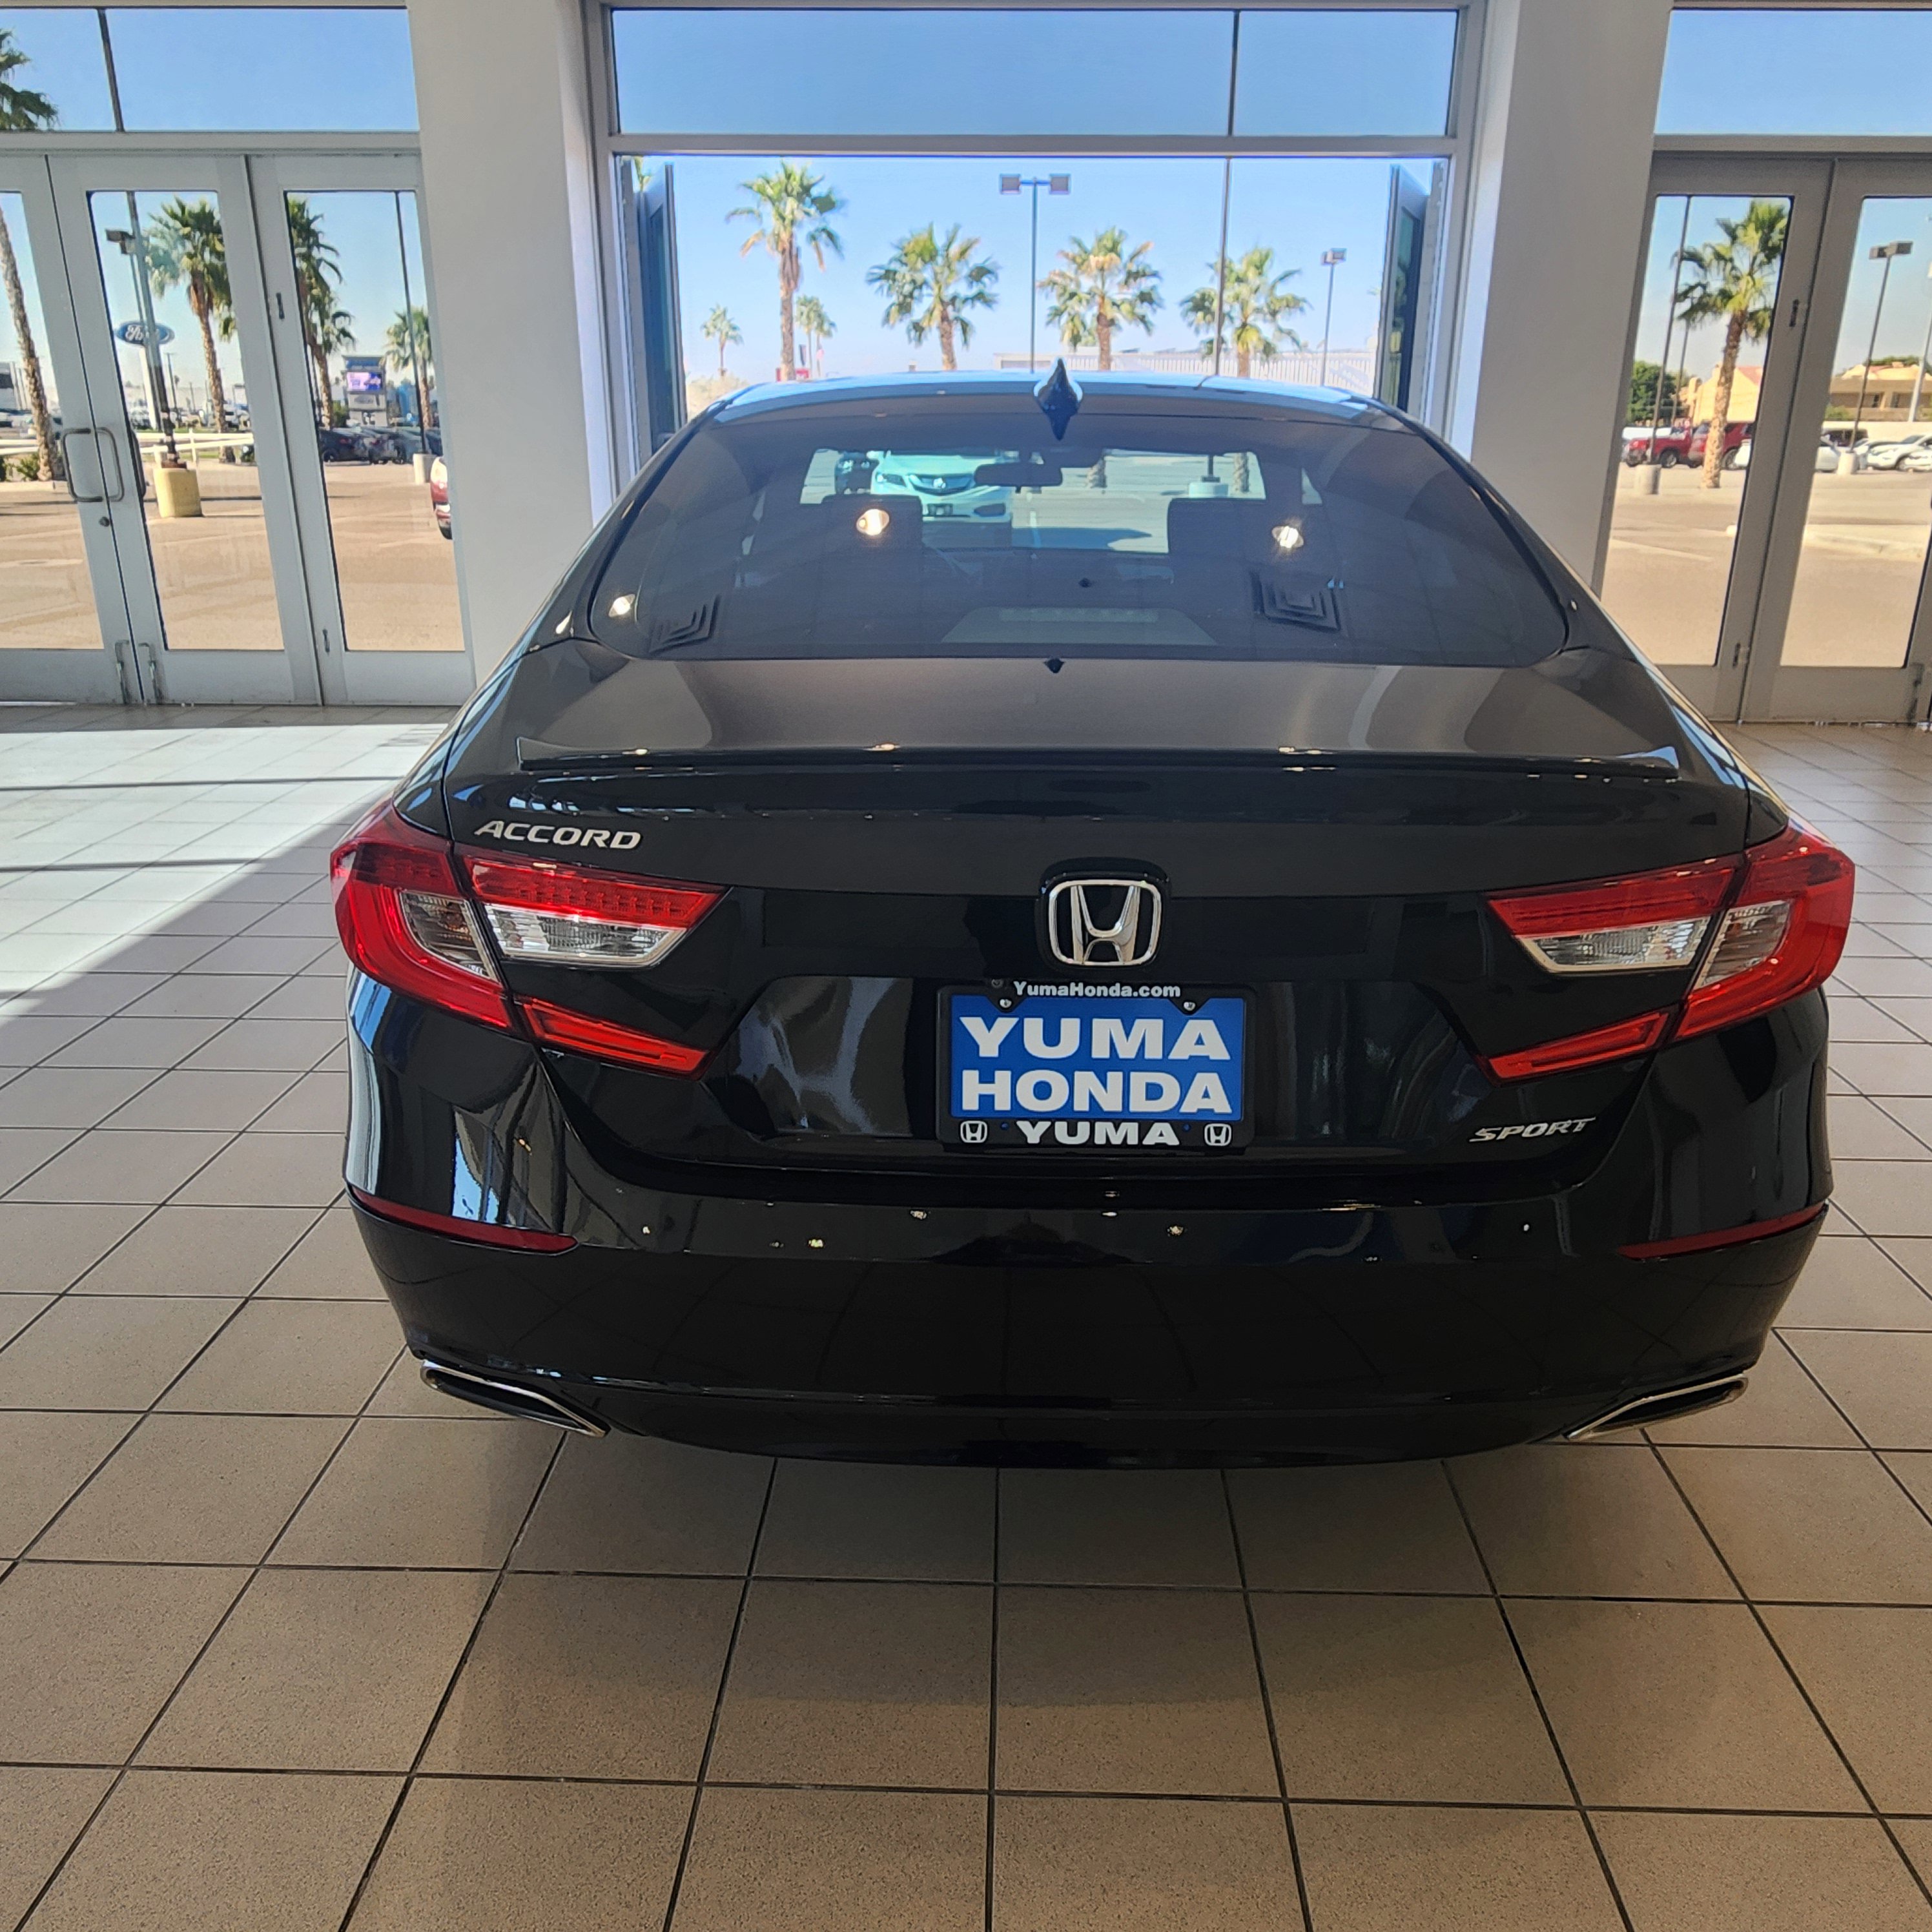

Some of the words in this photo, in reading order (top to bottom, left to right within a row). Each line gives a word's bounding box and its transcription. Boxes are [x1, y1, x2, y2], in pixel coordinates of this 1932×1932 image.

[474, 820, 641, 850] ACCORD
[1013, 981, 1181, 998] YumaHonda.com
[960, 1016, 1231, 1060] YUMA
[961, 1069, 1233, 1113] HONDA
[1016, 1120, 1180, 1146] YUMA
[1469, 1116, 1596, 1142] SPORT
